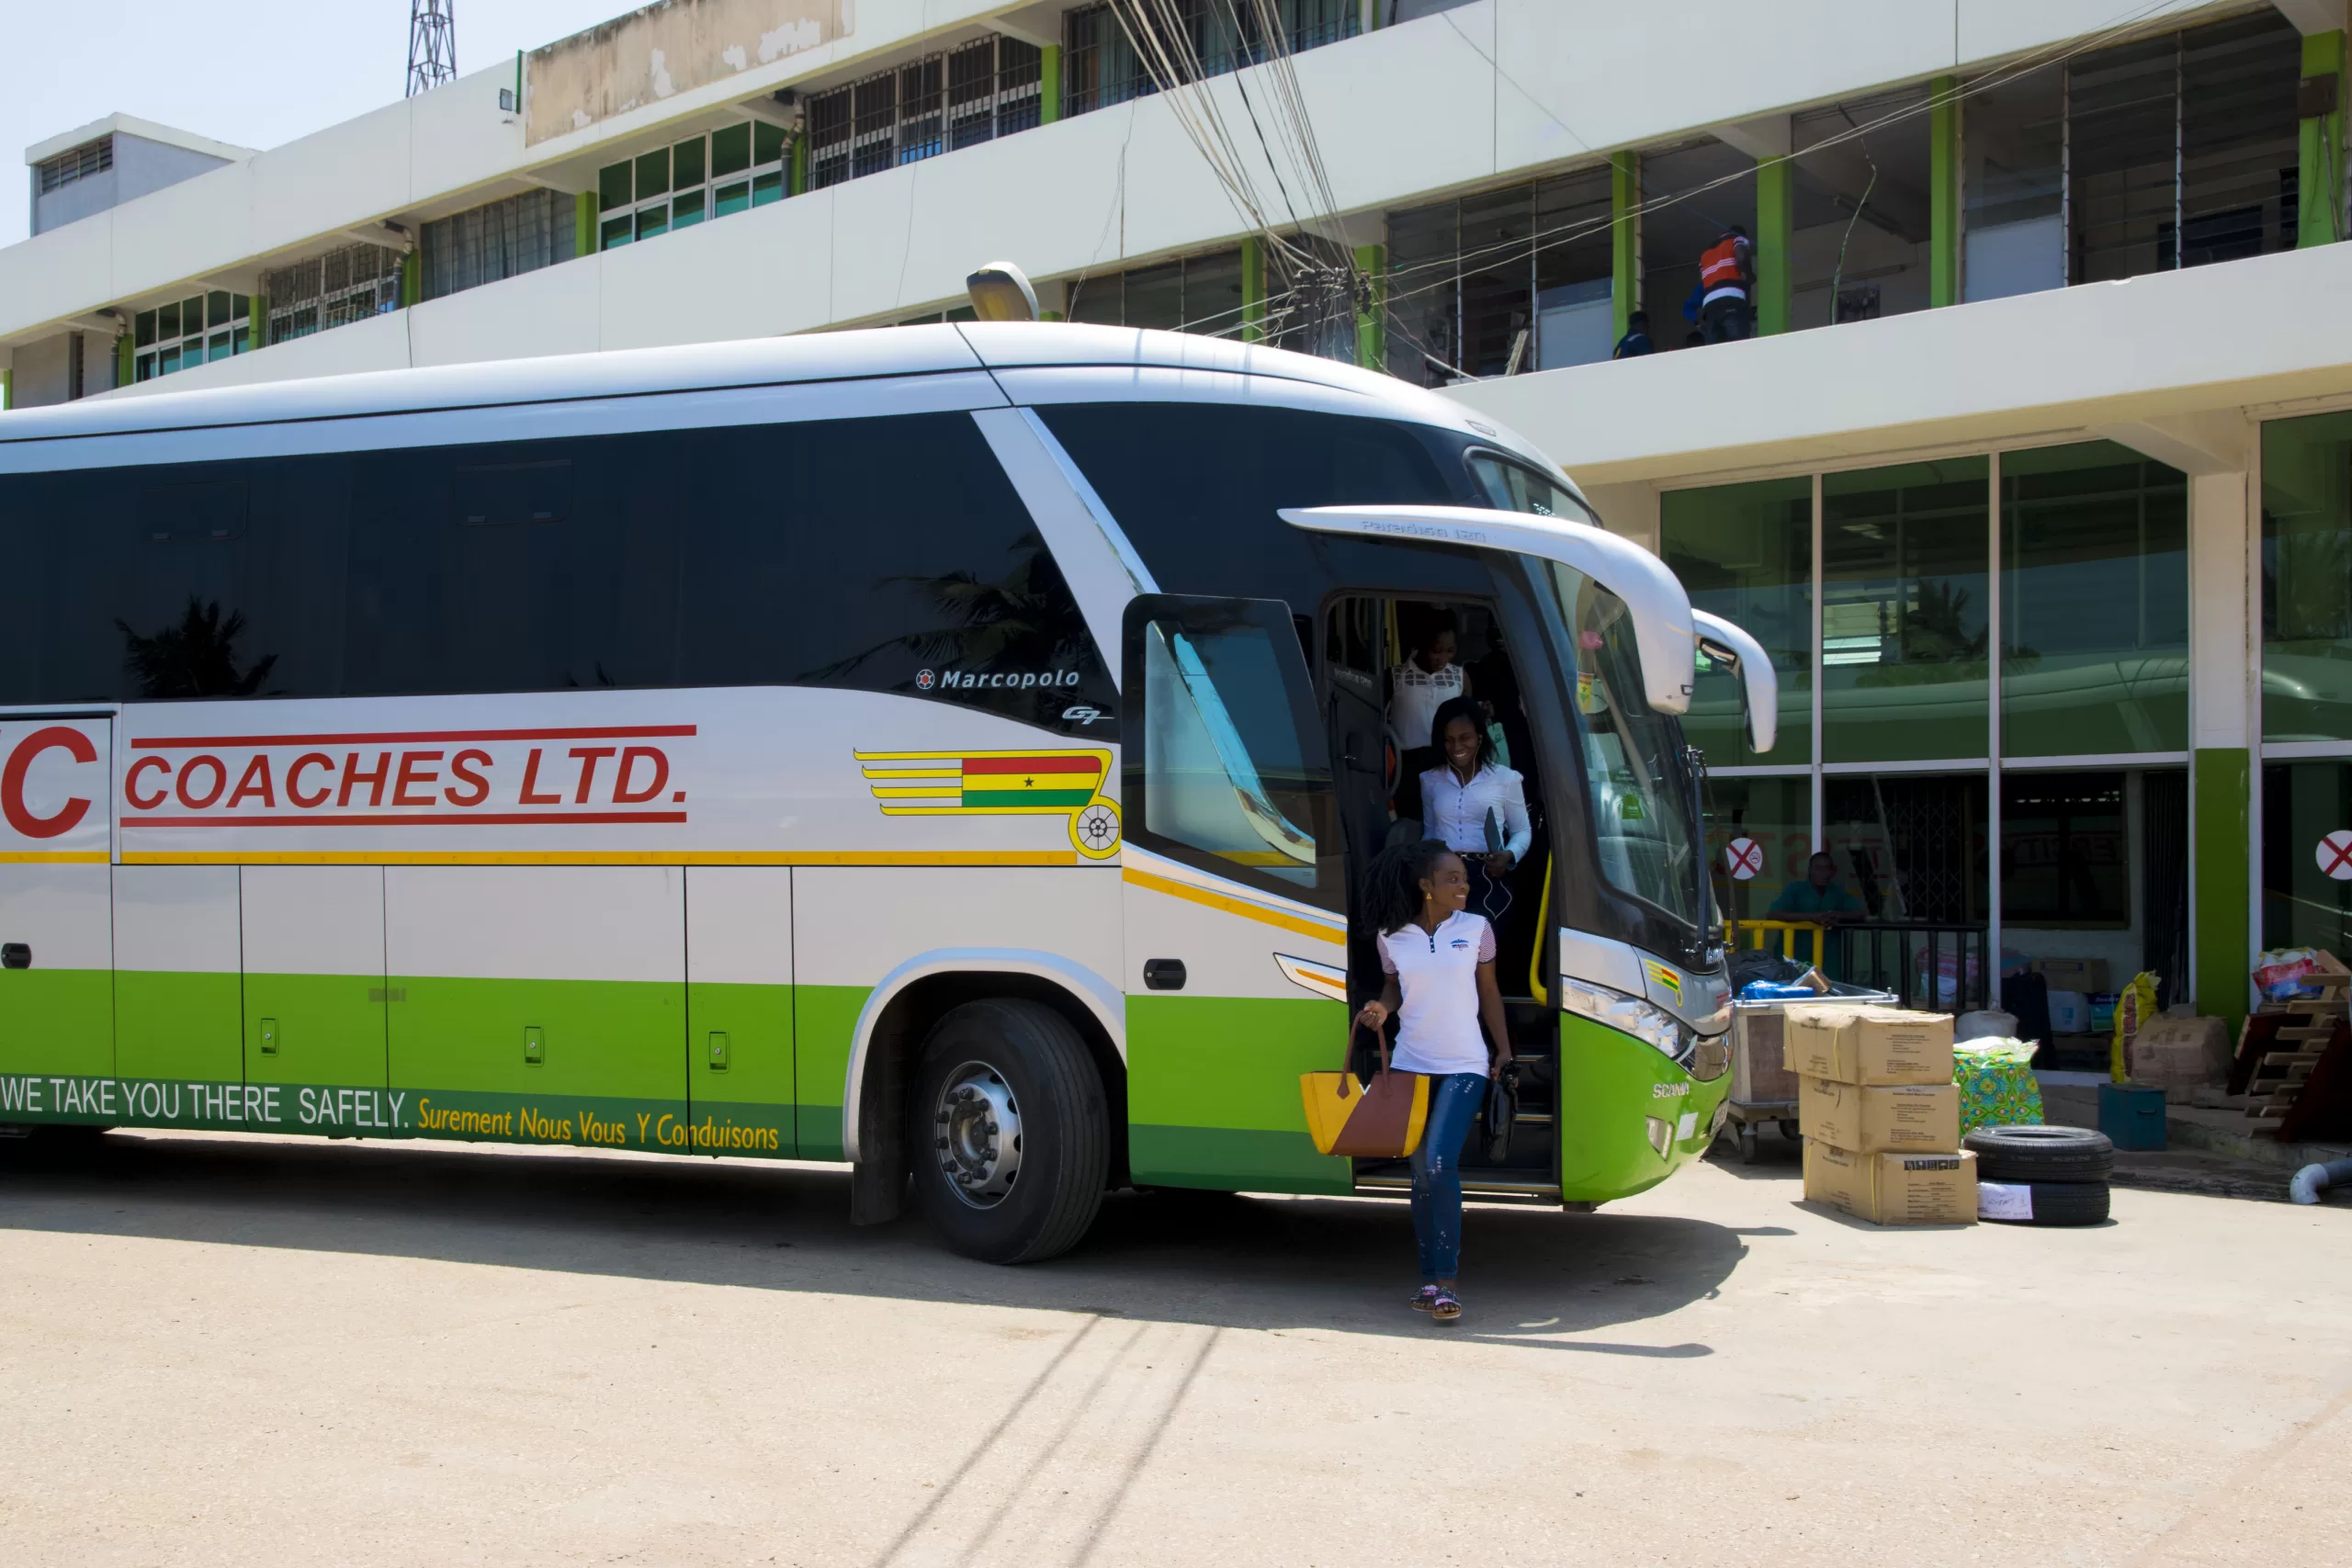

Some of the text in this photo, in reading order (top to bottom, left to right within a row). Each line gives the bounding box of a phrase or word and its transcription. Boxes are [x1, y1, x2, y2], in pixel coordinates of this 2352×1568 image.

[940, 669, 1080, 689] Marcopolo
[124, 749, 493, 810] COACHES
[517, 745, 687, 805] LTD.
[0, 1077, 410, 1129] WE TAKE YOU THERE SAFELY.
[418, 1098, 779, 1151] Surement Nous Vous Y Conduisons
